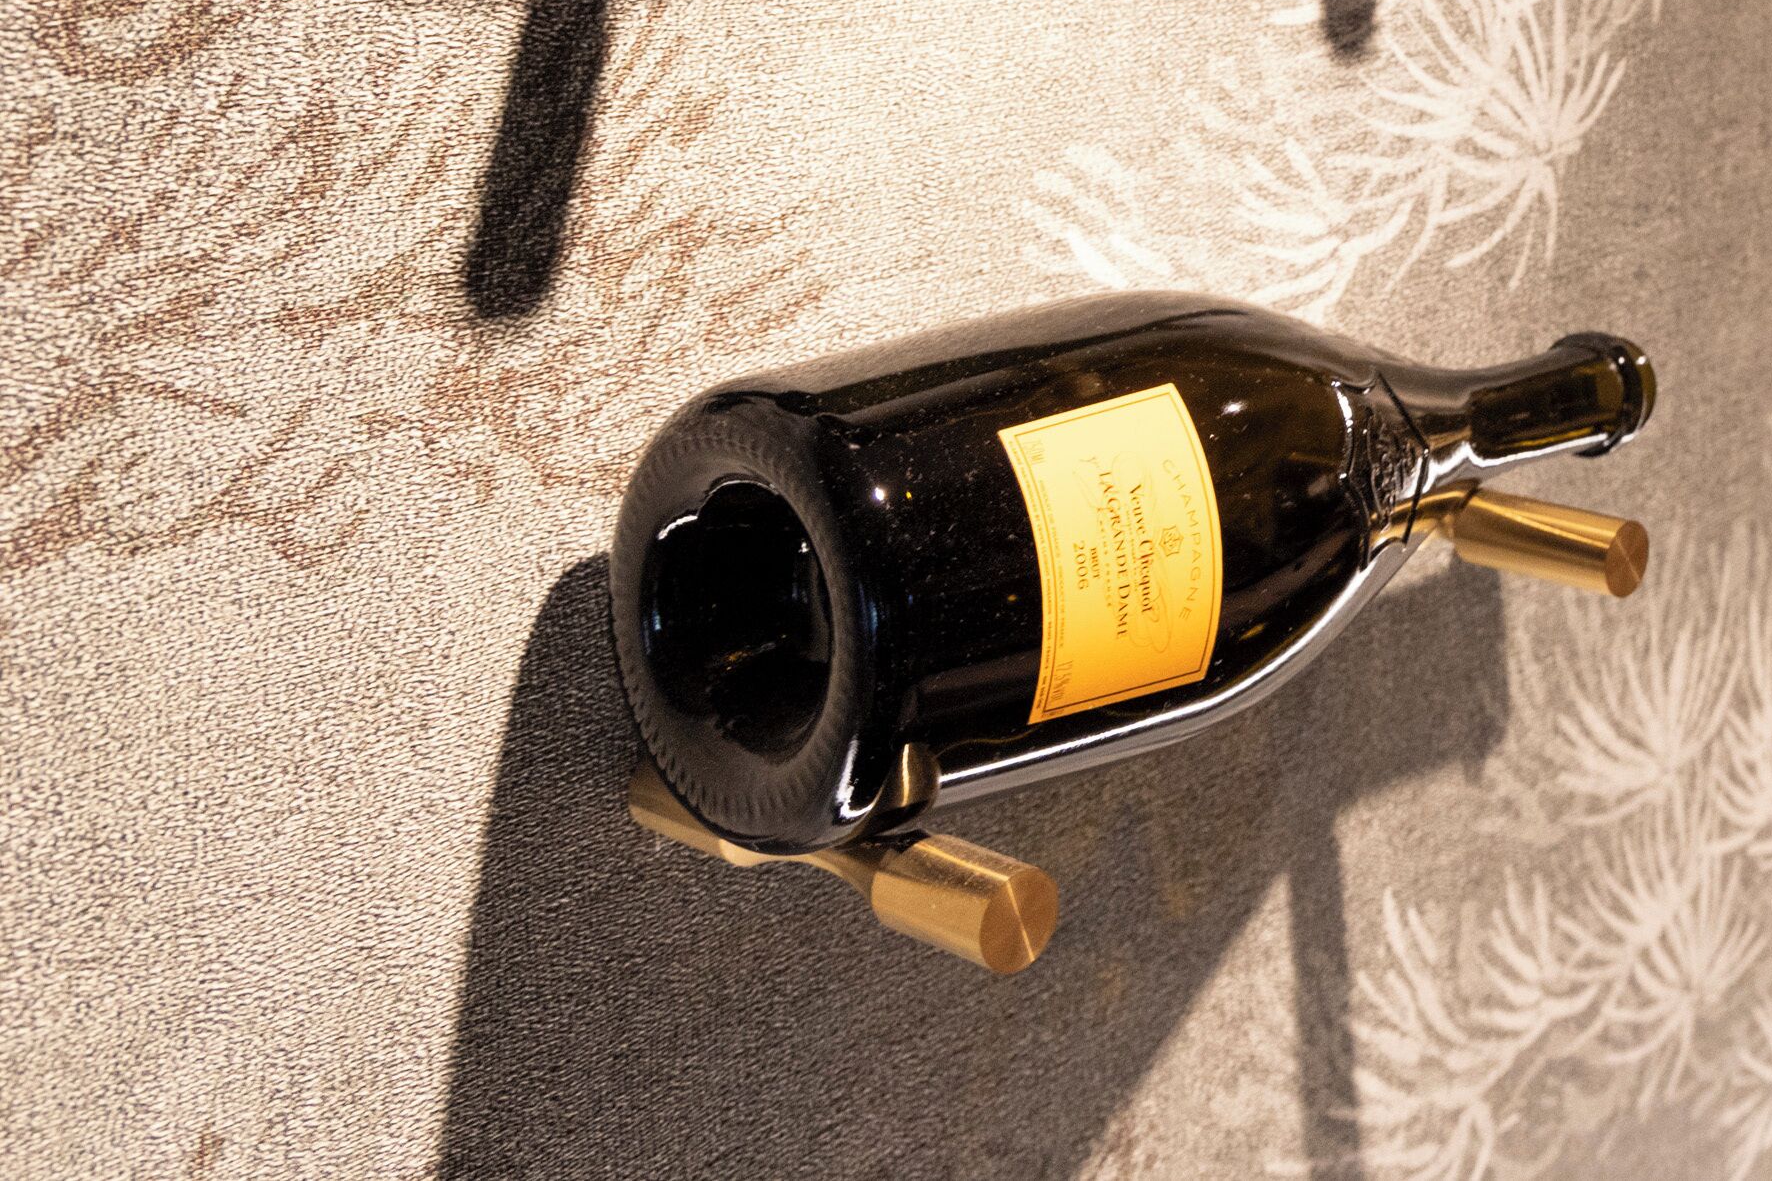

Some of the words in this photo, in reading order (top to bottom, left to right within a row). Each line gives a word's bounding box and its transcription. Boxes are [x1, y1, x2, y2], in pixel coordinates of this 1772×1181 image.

[1098, 470, 1119, 494] LA
[1128, 482, 1149, 535] Veuve
[1072, 539, 1090, 591] 2006
[1089, 546, 1102, 581] BRUT
[1105, 496, 1132, 581] GRANDE
[1160, 458, 1204, 622] CHAMPAGNE
[1135, 538, 1157, 615] Clicquot
[1115, 583, 1132, 641] DAME
